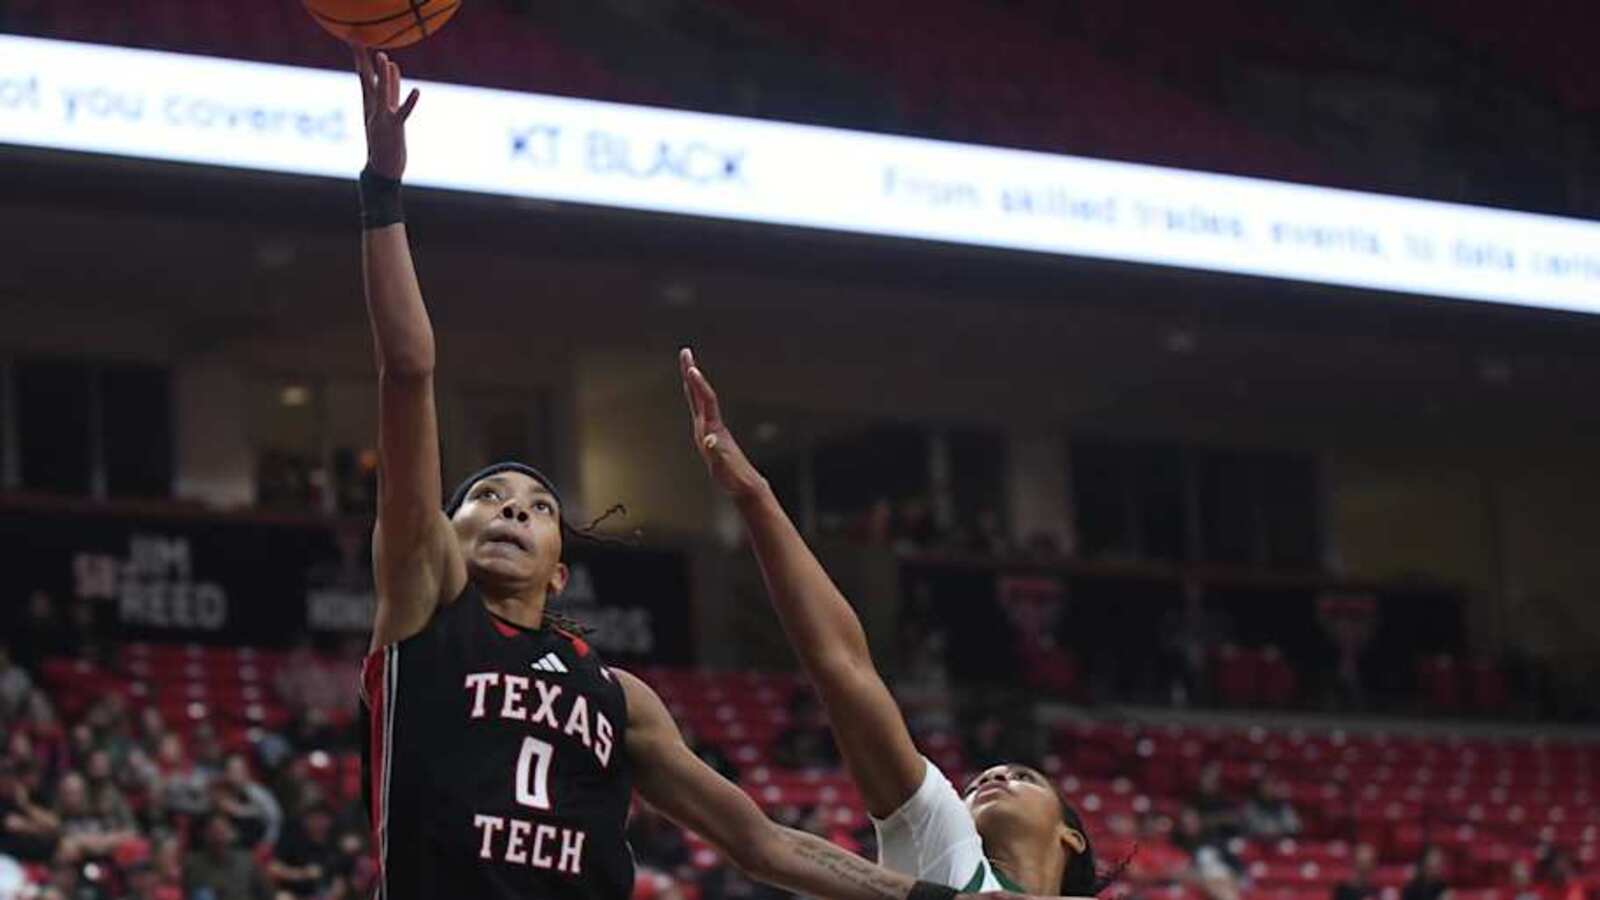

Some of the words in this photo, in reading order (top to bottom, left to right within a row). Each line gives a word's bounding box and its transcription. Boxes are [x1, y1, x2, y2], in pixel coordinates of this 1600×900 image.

[58, 85, 146, 128] you
[162, 93, 347, 143] covered
[584, 130, 748, 188] BLACK
[118, 579, 228, 630] REED
[464, 672, 614, 768] TEXAS
[515, 735, 554, 811] 0
[473, 813, 585, 875] TECH
